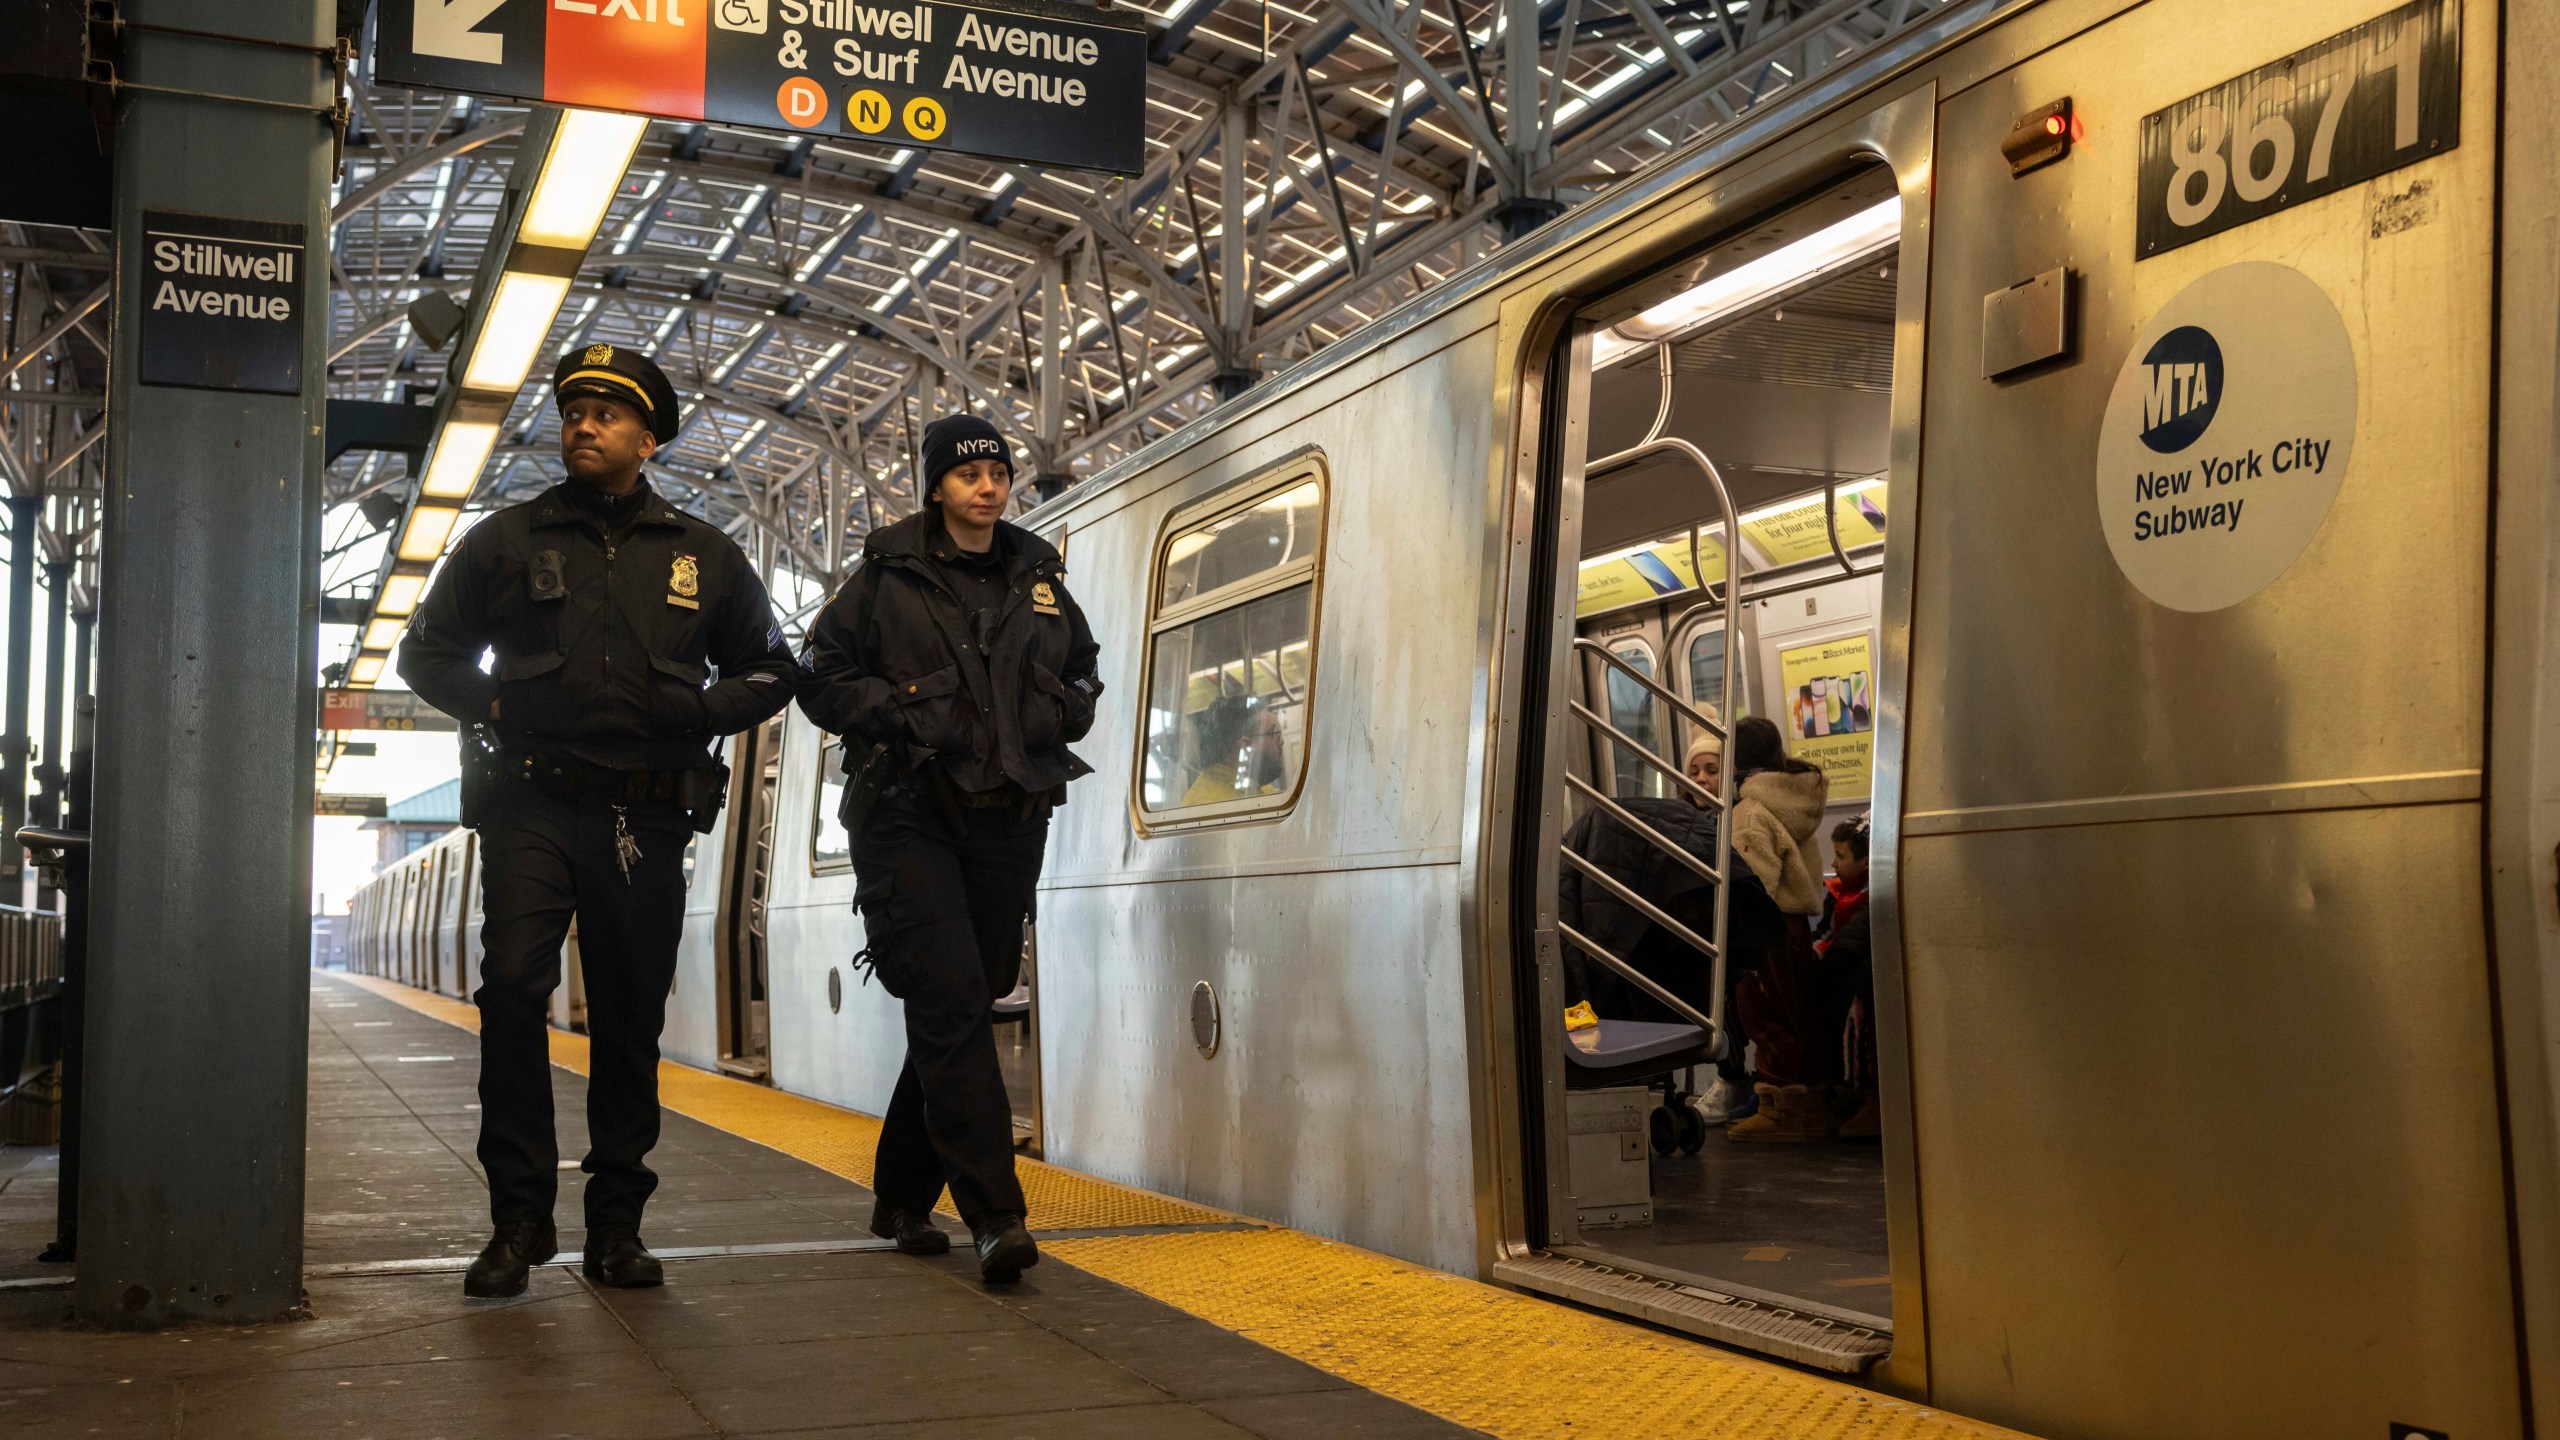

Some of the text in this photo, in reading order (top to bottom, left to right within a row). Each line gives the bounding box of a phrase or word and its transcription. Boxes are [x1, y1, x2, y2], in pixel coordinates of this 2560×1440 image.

[779, 0, 1099, 66] Stillwell Avenue
[777, 29, 1087, 107] & Surf Avenue
[791, 87, 937, 132] D N Q
[2166, 15, 2422, 227] 8671
[154, 240, 294, 283] Stillwell
[152, 280, 291, 321] Avenue
[2140, 362, 2208, 434] MTA
[956, 438, 999, 456] NYPD
[2135, 438, 2331, 503] New York City
[1765, 527, 1783, 539] for
[1781, 522, 1804, 538] four
[1774, 511, 1794, 522] one
[2134, 498, 2244, 541] Subway
[1828, 645, 1866, 658] Back Market
[326, 692, 360, 709] Exit
[1811, 748, 1821, 758] on
[1822, 746, 1839, 759] your
[1840, 744, 1855, 754] own
[1856, 740, 1869, 755] lap
